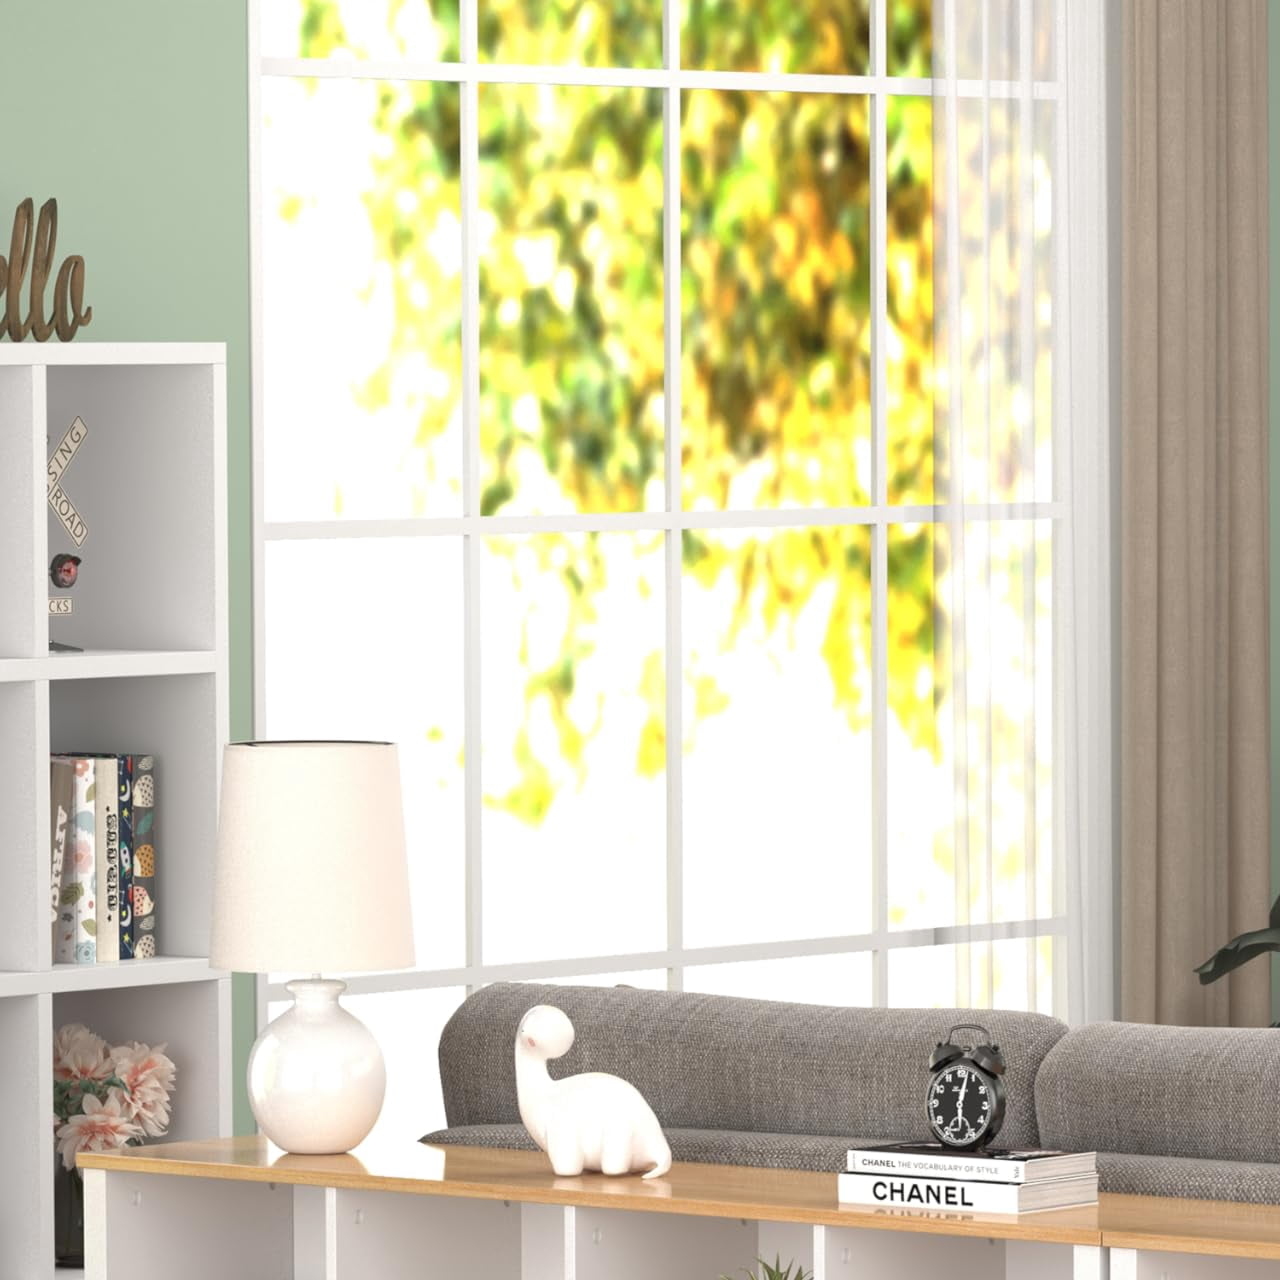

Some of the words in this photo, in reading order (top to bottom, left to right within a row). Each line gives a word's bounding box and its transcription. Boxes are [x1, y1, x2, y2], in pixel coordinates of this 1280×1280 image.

[936, 1084, 945, 1094] 10
[932, 1099, 939, 1108] 9
[982, 1101, 989, 1110] 3
[936, 1115, 944, 1125] 8
[861, 1158, 896, 1168] CHANEL
[897, 1160, 912, 1169] THE
[913, 1161, 963, 1172] VOCABULARY
[964, 1165, 975, 1173] OF
[976, 1166, 999, 1175] STYLE
[872, 1180, 974, 1207] CHANEL
